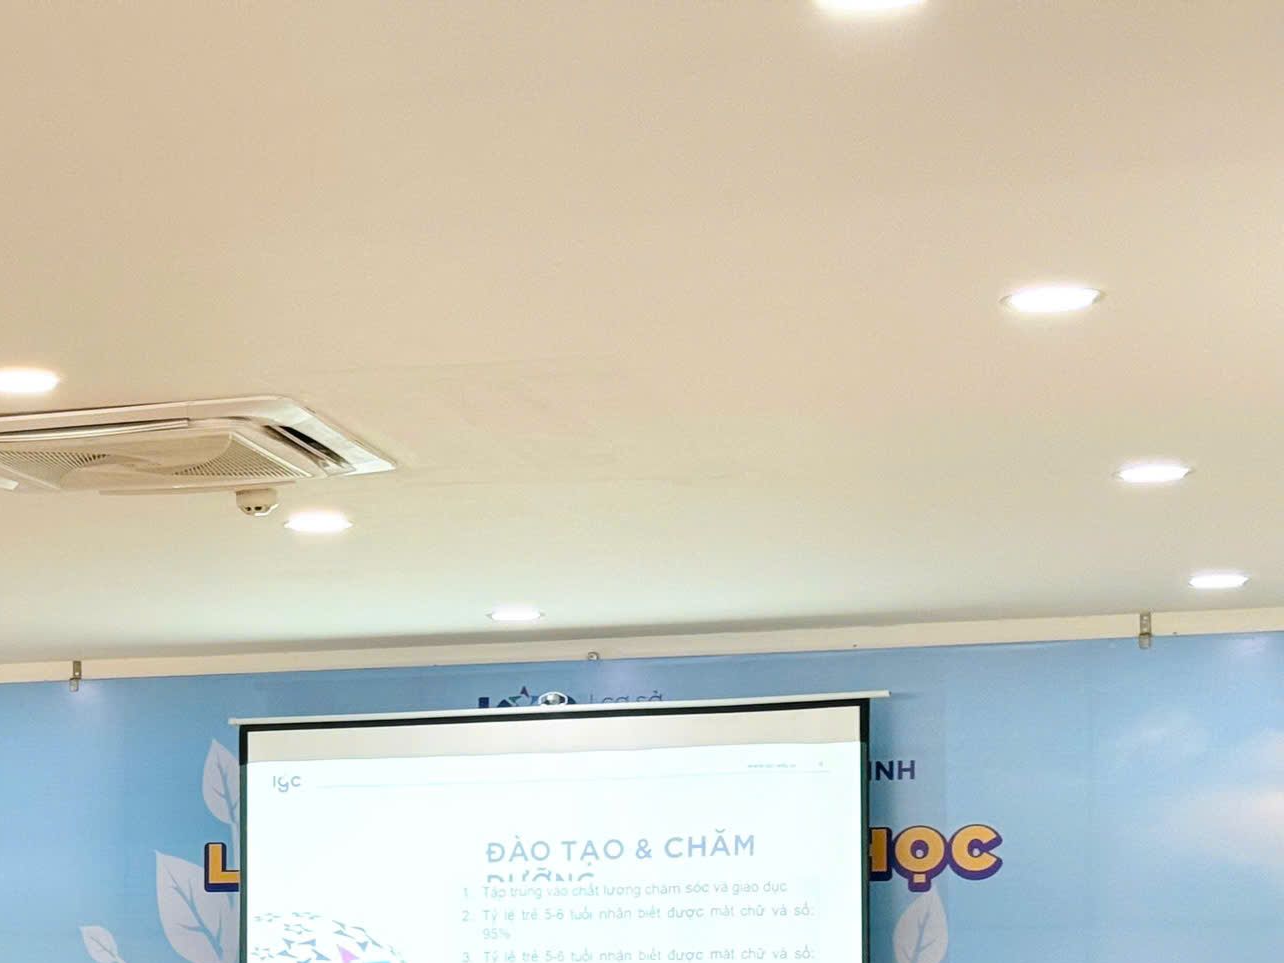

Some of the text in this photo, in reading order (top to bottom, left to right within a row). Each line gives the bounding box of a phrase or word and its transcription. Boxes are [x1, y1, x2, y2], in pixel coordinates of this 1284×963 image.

[486, 828, 755, 866] ĐÀO TẠO & CHĂM
